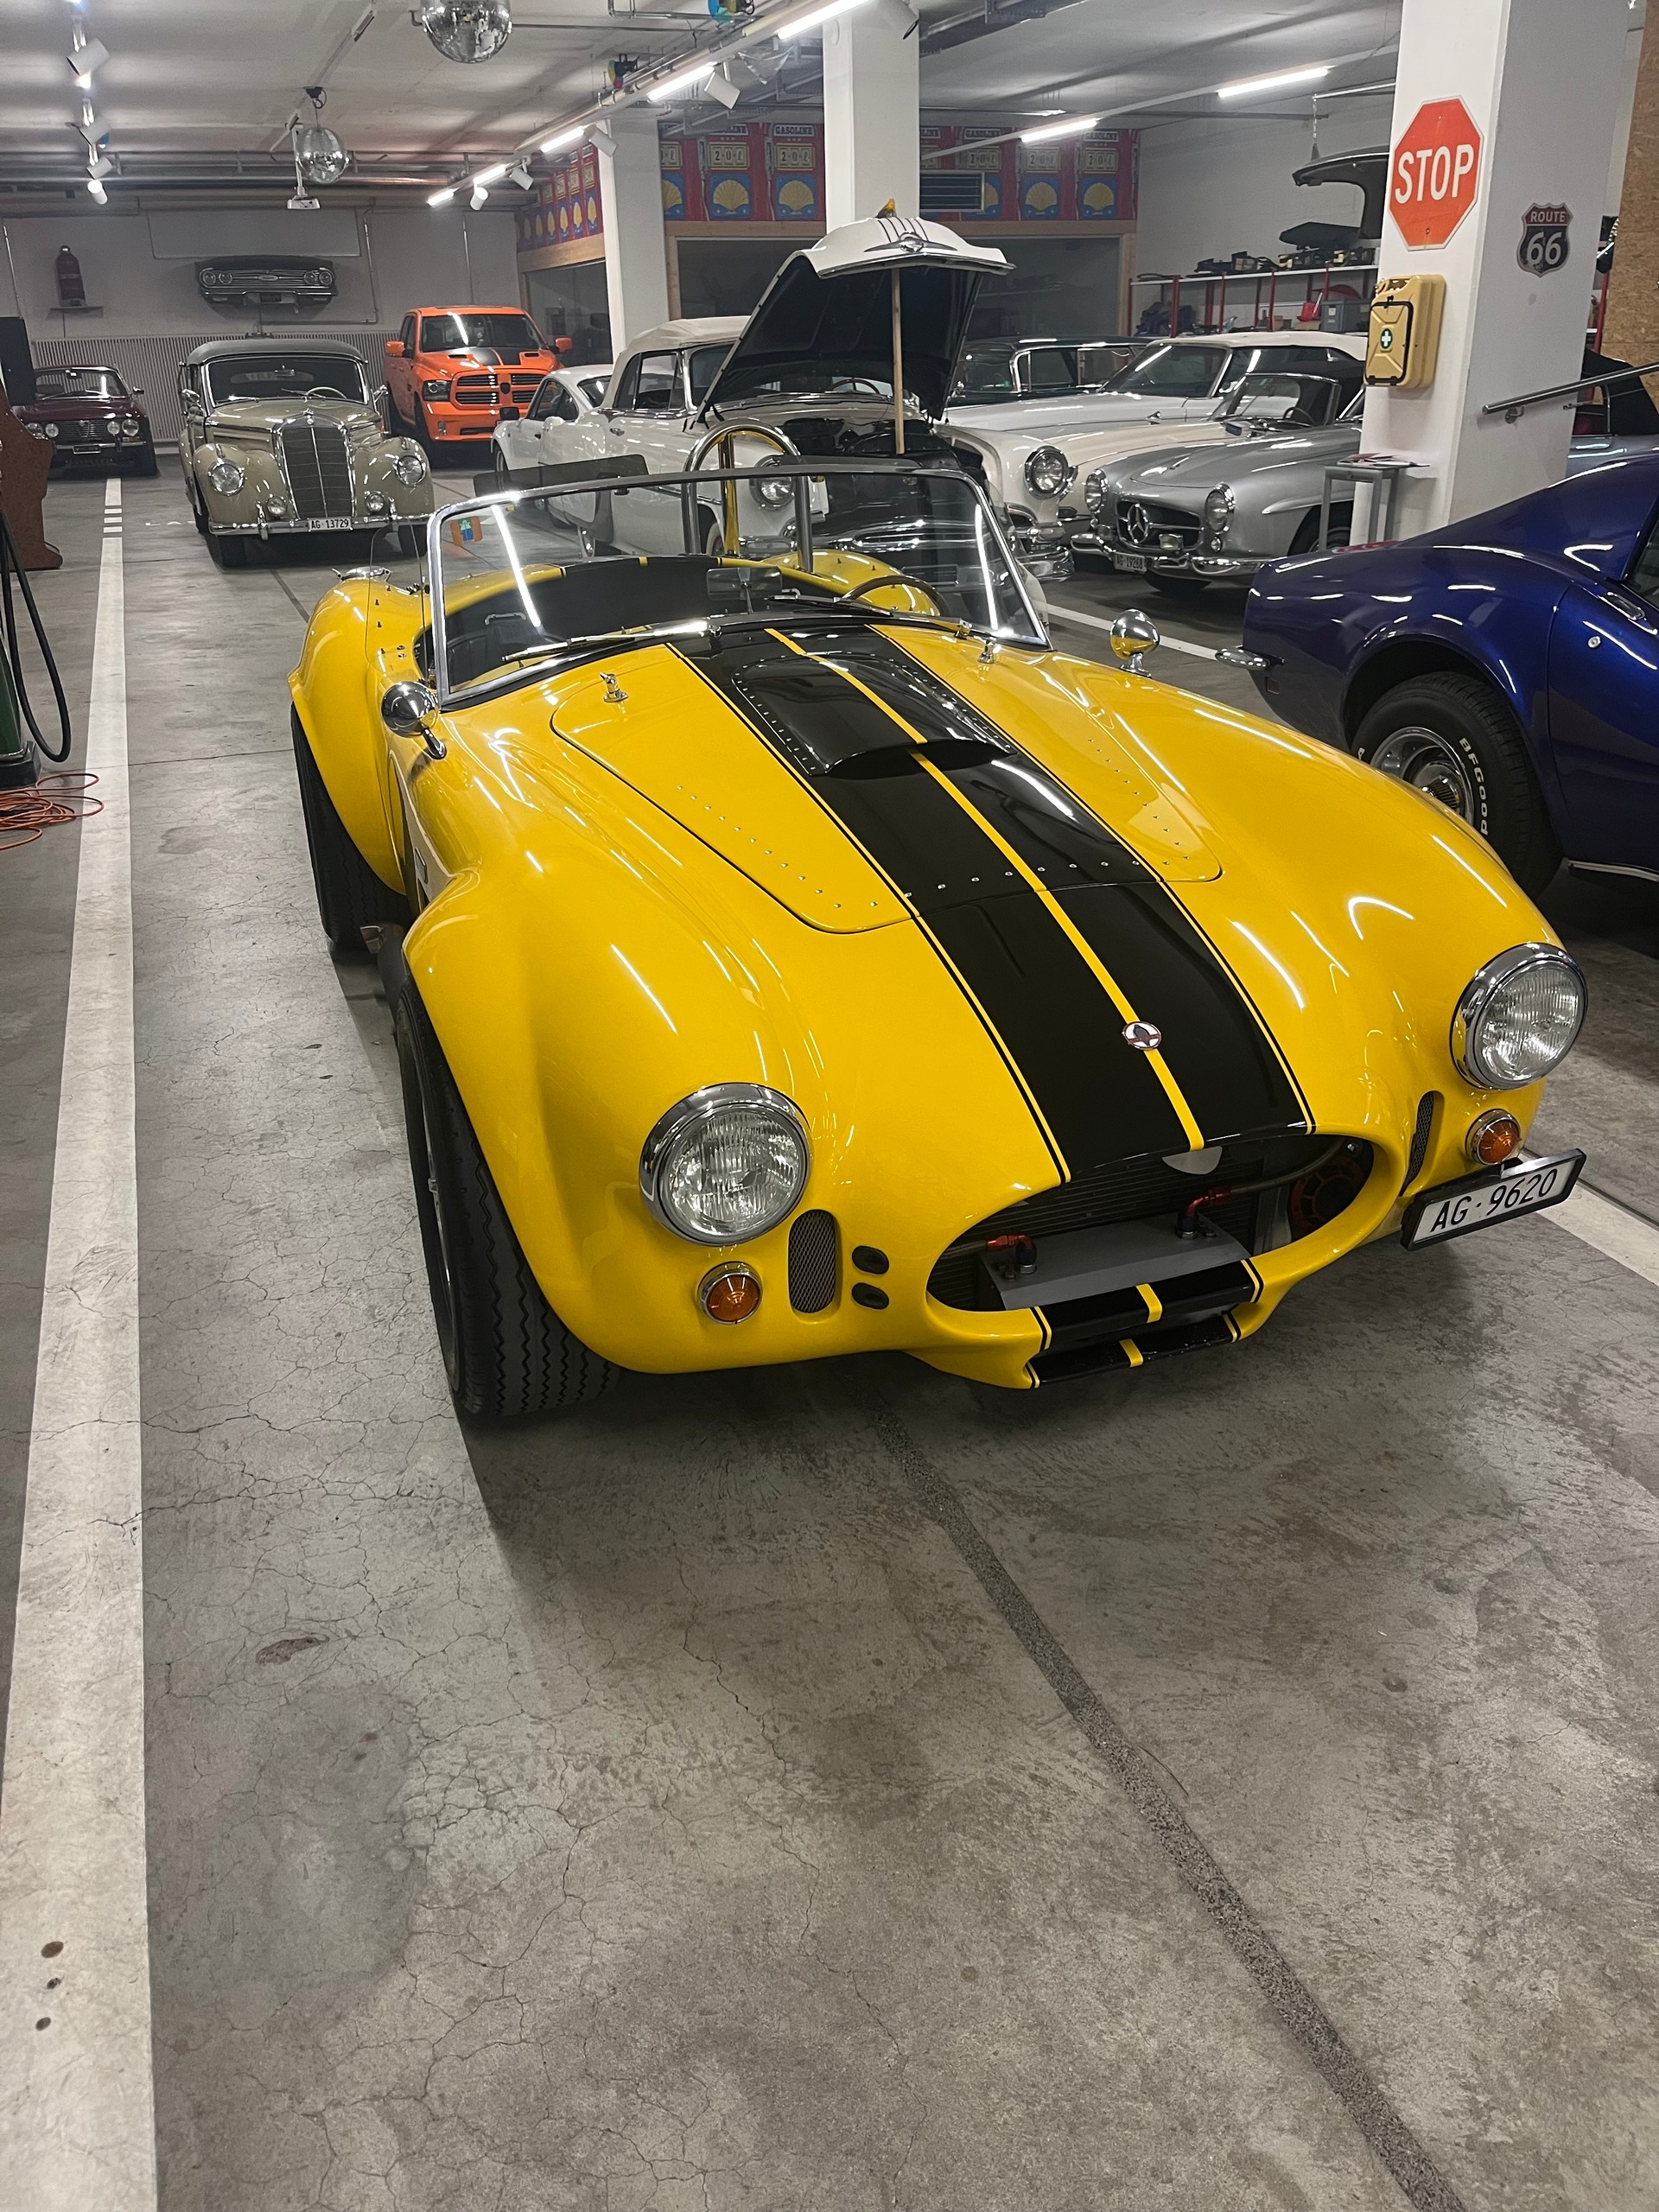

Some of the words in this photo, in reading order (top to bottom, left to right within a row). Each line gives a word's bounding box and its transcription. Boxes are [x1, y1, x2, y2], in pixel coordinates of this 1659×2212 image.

[775, 126, 813, 135] GASOLINE
[1395, 143, 1474, 204] STOP
[1530, 211, 1566, 223] ROUTE
[1526, 231, 1563, 265] 66
[1459, 737, 1489, 836] BFGood
